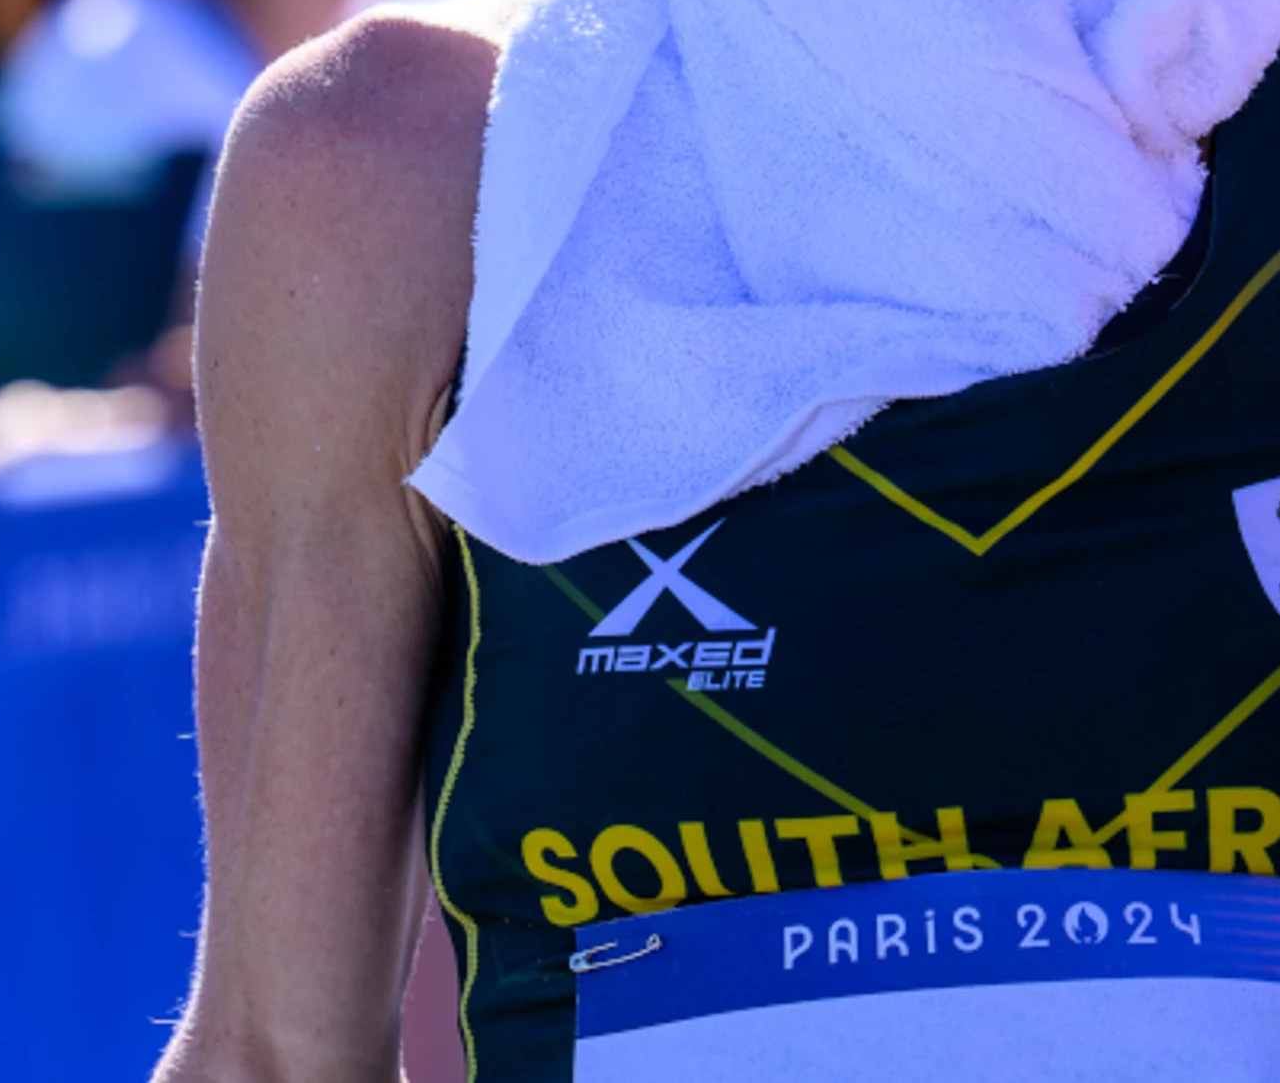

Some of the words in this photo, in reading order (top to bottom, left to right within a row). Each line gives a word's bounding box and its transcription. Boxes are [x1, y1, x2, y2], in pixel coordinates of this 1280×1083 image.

[686, 669, 766, 691] ELITE
[521, 806, 975, 927] SOUTH
[1016, 900, 1202, 948] 2024
